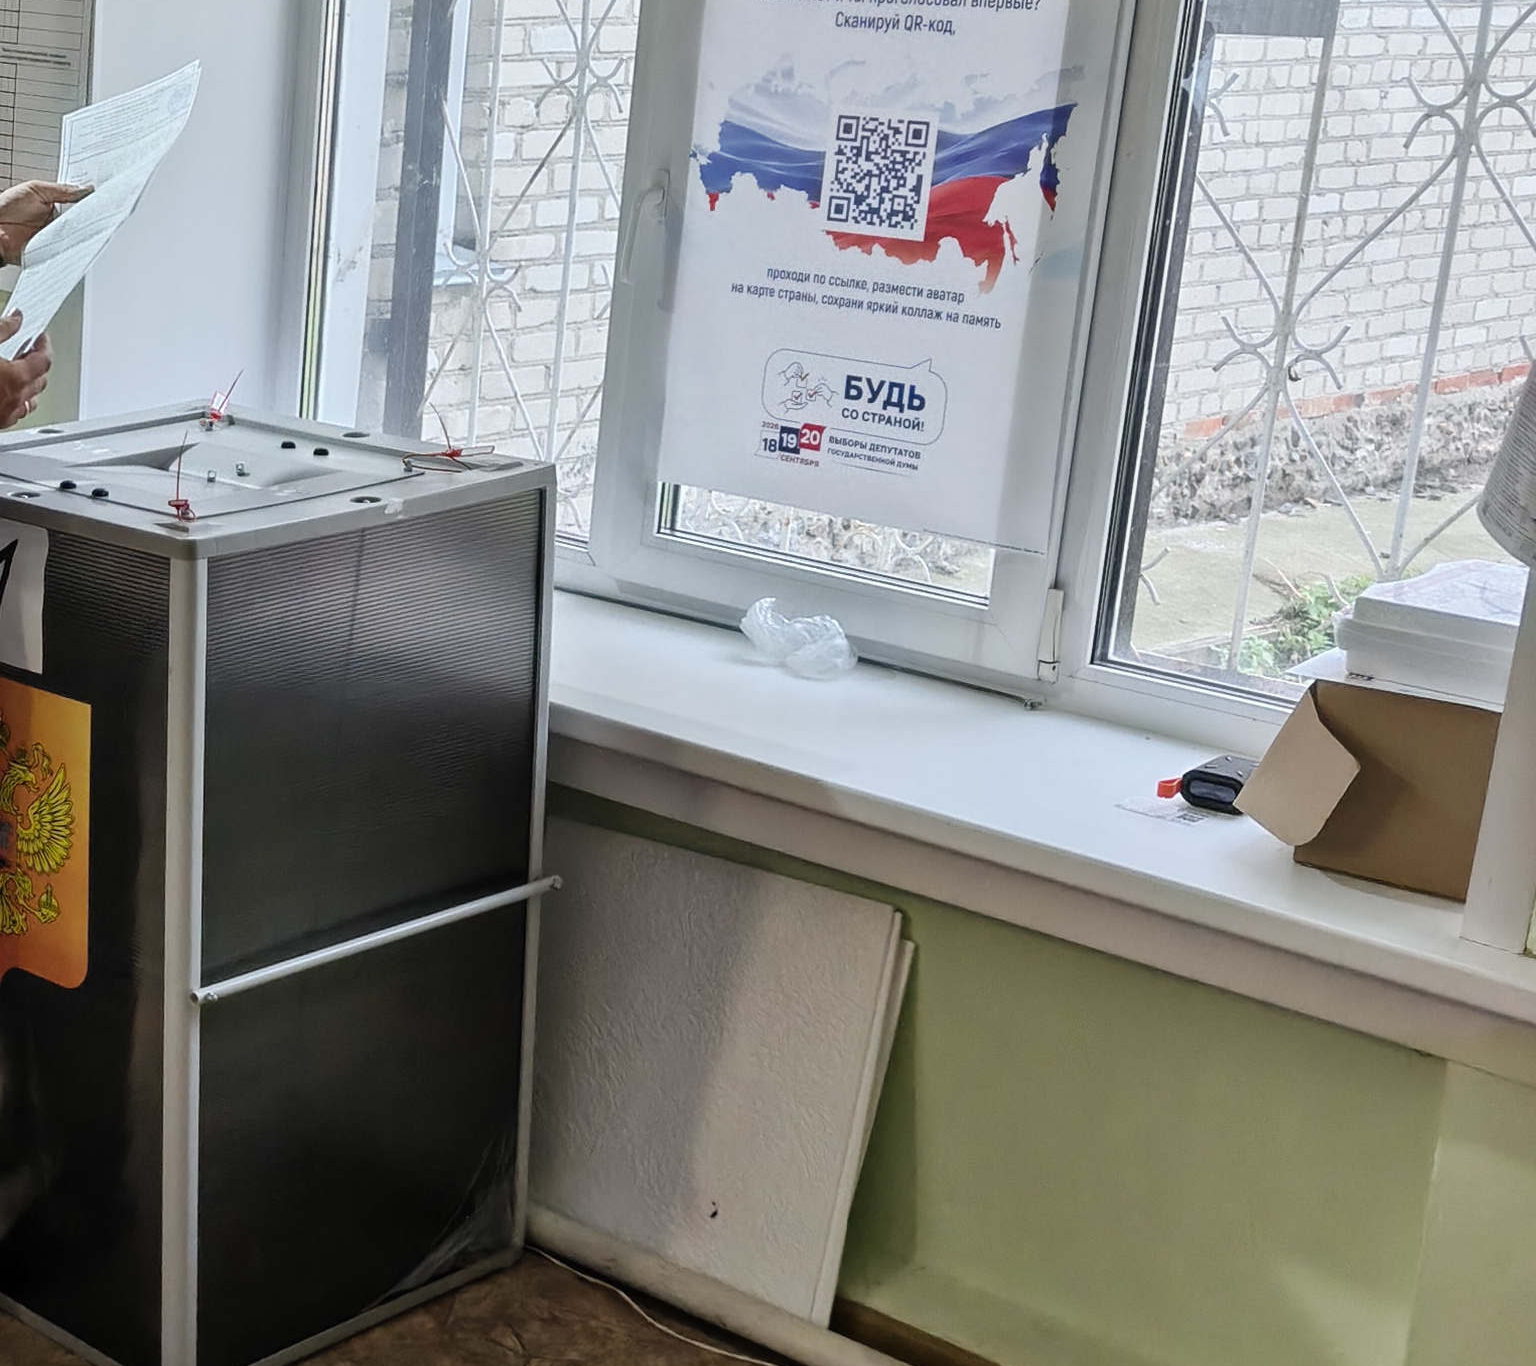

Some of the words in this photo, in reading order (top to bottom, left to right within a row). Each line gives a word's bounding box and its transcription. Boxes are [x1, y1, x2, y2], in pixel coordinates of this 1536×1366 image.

[835, 11, 901, 34] Сканируй
[903, 14, 956, 36] QR-код,
[766, 266, 811, 284] проходи
[813, 273, 826, 285] по
[828, 274, 870, 293] ссылке,
[871, 280, 924, 298] размести
[926, 287, 965, 304] аватар
[731, 282, 744, 294] на
[746, 285, 776, 300] карте
[777, 288, 818, 306] страны,
[821, 293, 864, 310] сохрани
[866, 299, 899, 316] яркий
[901, 305, 943, 322] коллаж
[945, 311, 959, 324] на
[961, 313, 1002, 330] память
[844, 374, 926, 414] БУДЬ
[841, 407, 859, 420] СО
[861, 410, 925, 433] СТРАНОЙ!
[762, 437, 778, 454] 18
[780, 432, 798, 449] 19
[799, 428, 821, 446] 20
[828, 435, 868, 451] ВЫБОРЫ
[868, 441, 922, 460] ДЕПУТАТОВ
[780, 454, 820, 468] СЕНТЯБРЯ
[827, 447, 895, 467] ГОСУДАРСТВЕННОЙ
[896, 460, 919, 471] ДУМЫ
